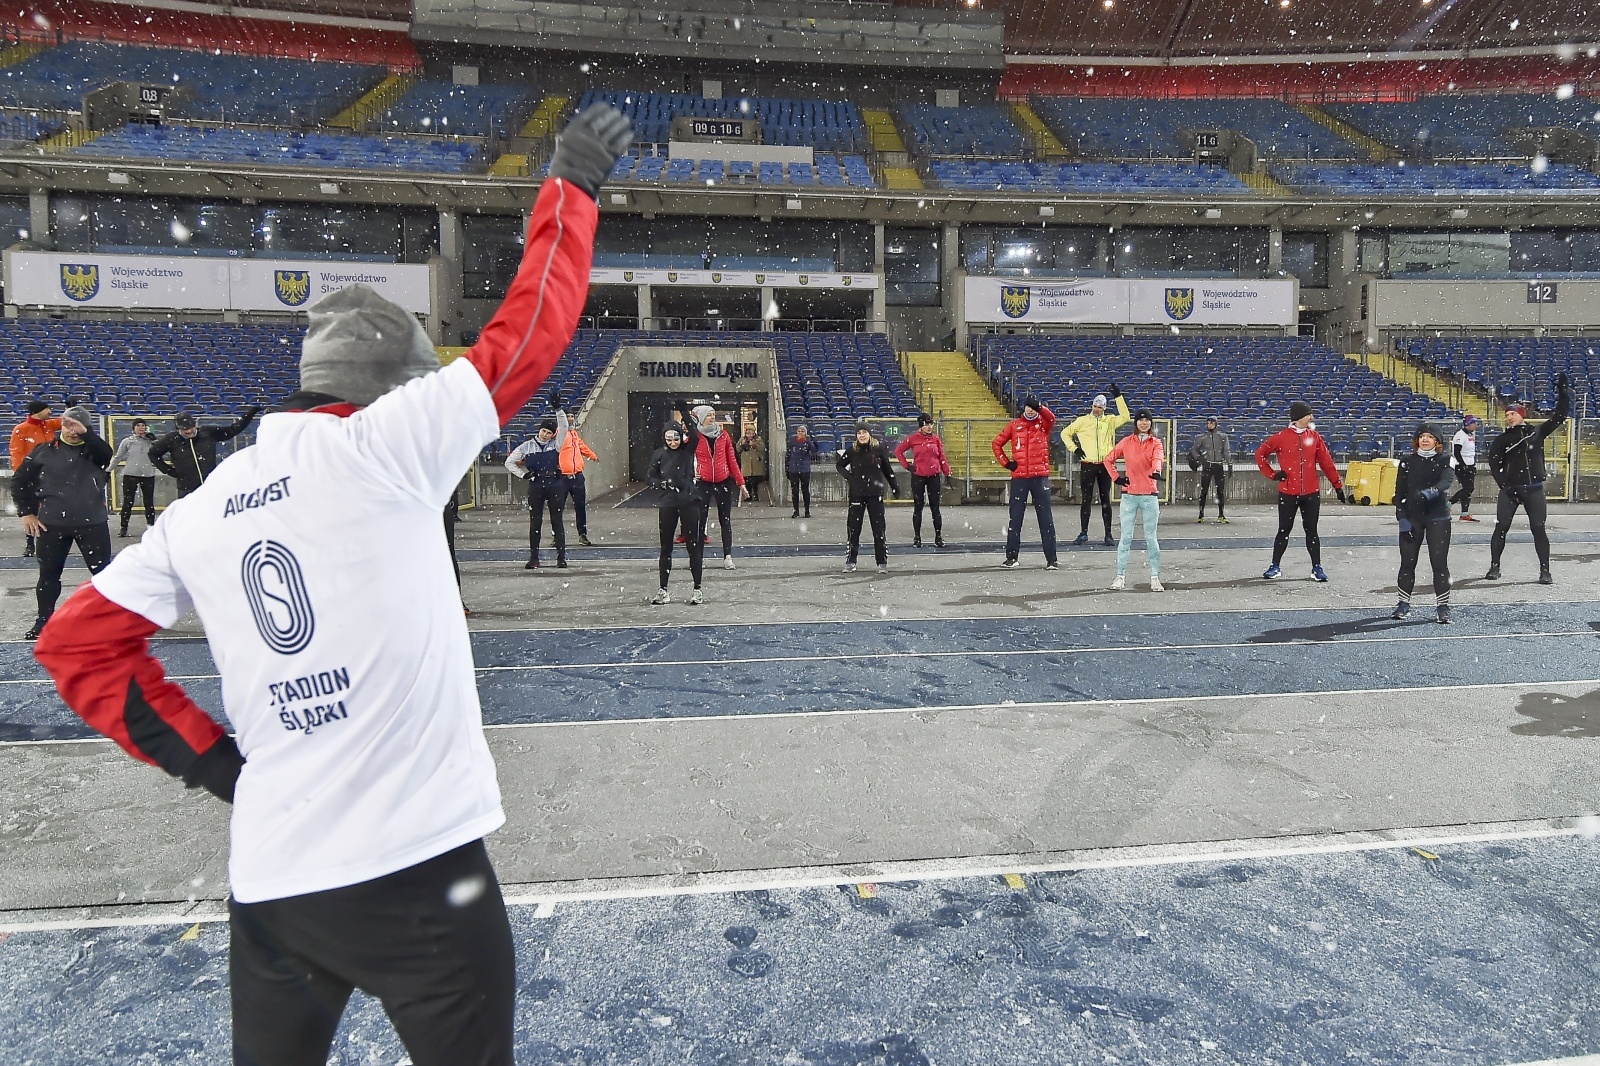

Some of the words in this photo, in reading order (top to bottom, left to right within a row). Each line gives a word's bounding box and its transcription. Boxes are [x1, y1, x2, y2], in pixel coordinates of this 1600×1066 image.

[142, 89, 158, 101] 08
[695, 123, 707, 133] 09
[710, 125, 716, 134] G
[720, 124, 732, 134] 10
[735, 126, 740, 135] G
[1196, 135, 1207, 145] 11
[1210, 137, 1216, 145] G
[110, 266, 183, 278] Województwo
[320, 272, 387, 283] Województwo
[111, 278, 149, 290] Śląskie
[1038, 287, 1095, 298] Województwo
[1202, 289, 1258, 300] Województwo
[1533, 286, 1552, 300] 12
[1038, 298, 1068, 309] Śląskie
[1202, 300, 1231, 311] Śląskie
[639, 361, 702, 378] STADION
[707, 358, 758, 383] ŚLĄSKI
[223, 475, 291, 519] AUGUST
[268, 666, 350, 706] STADION
